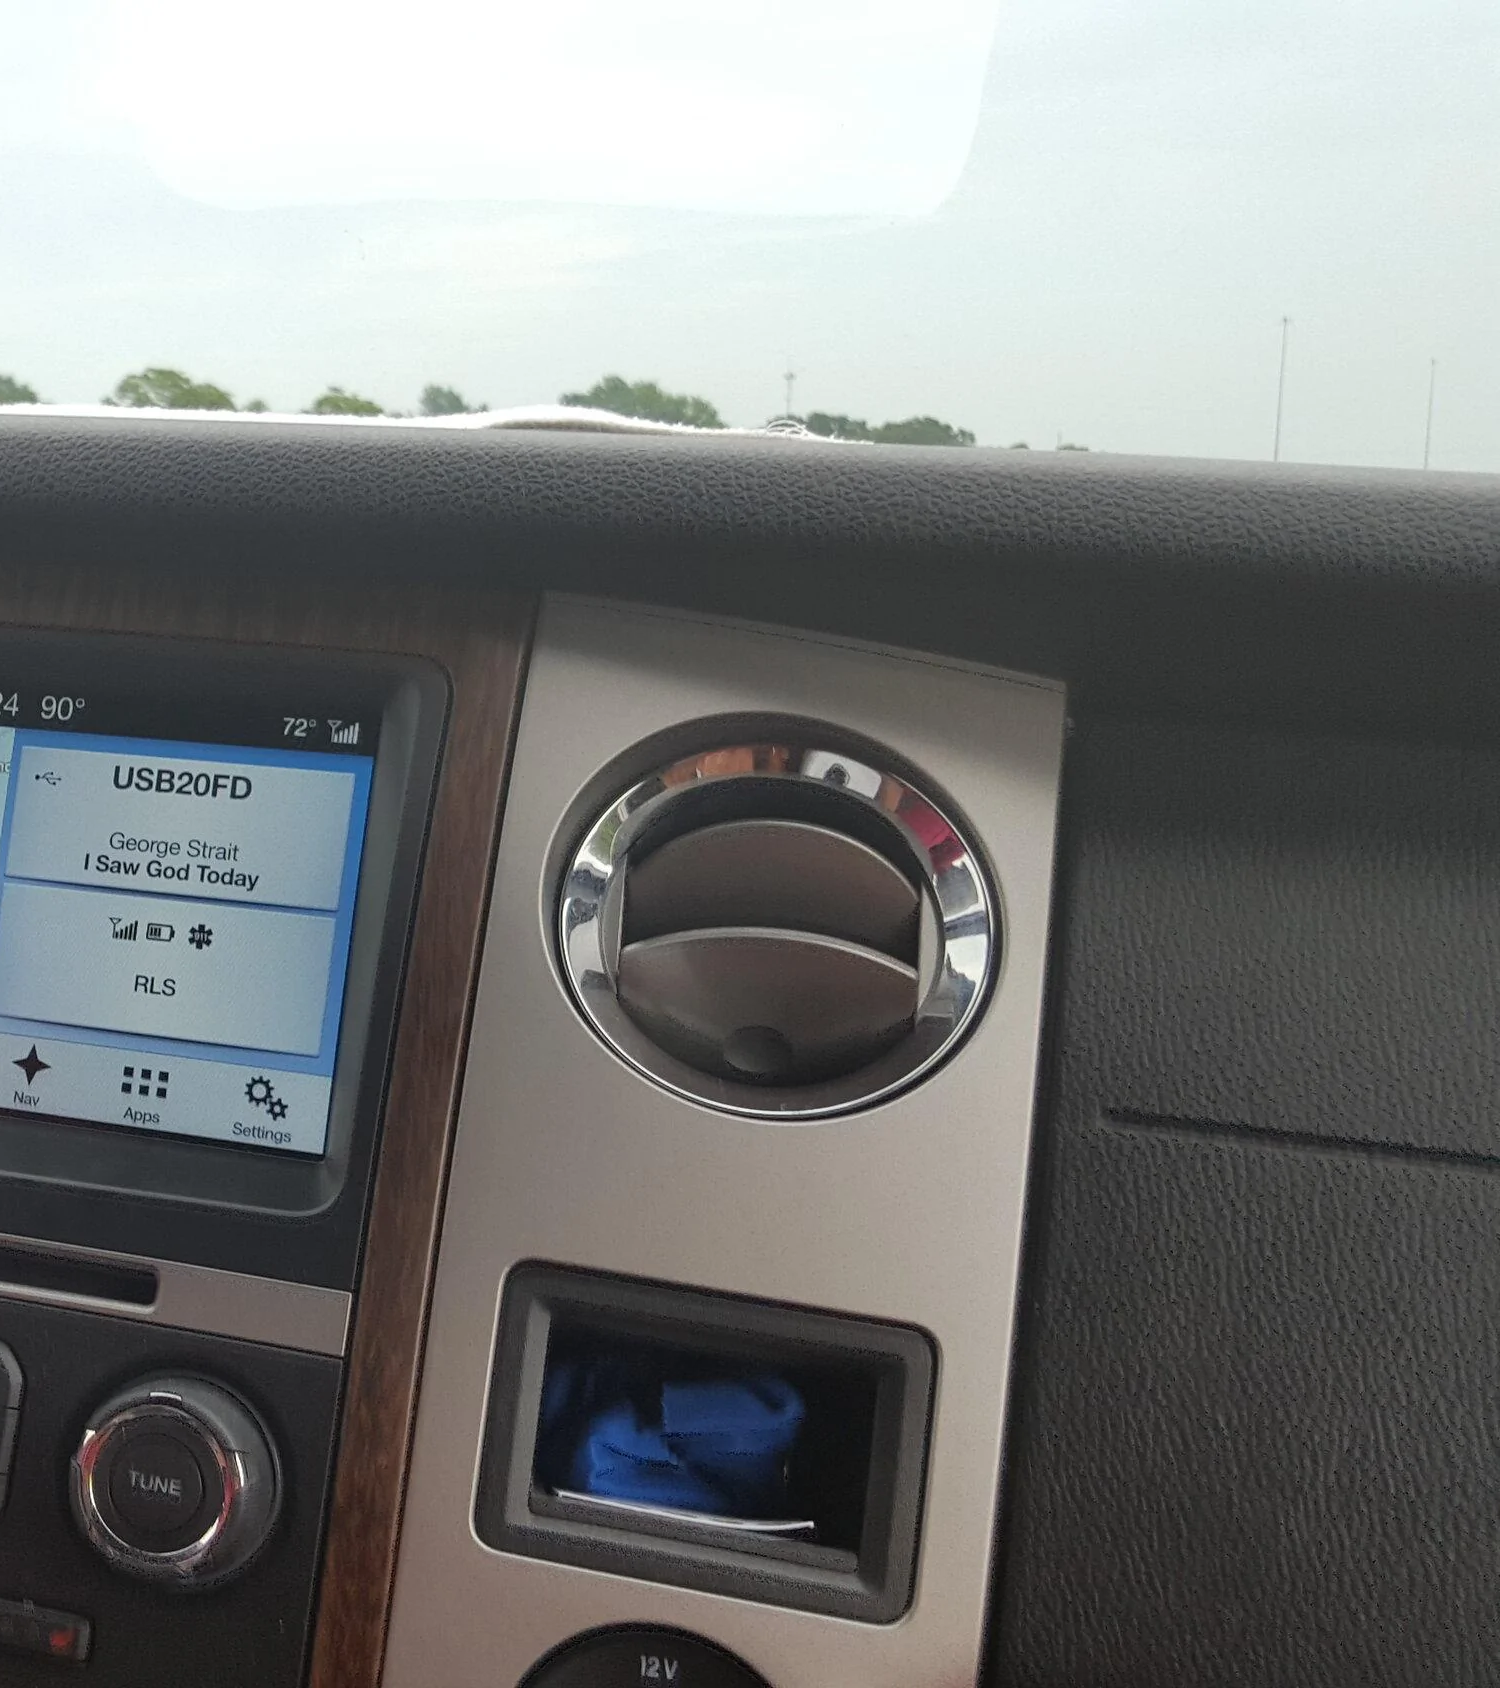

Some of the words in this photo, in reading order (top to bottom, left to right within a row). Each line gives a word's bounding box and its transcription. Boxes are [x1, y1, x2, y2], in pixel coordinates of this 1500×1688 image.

[113, 765, 252, 800] USB20FD
[109, 831, 181, 858] George
[187, 839, 239, 862] Strait
[84, 853, 90, 871] I
[96, 855, 140, 876] Saw
[146, 860, 190, 882] God
[197, 865, 260, 891] Today
[134, 975, 176, 997] RLS
[13, 1091, 40, 1107] Nav
[123, 1107, 160, 1124] Apps
[232, 1122, 291, 1143] Settings
[129, 1468, 182, 1496] TUNE
